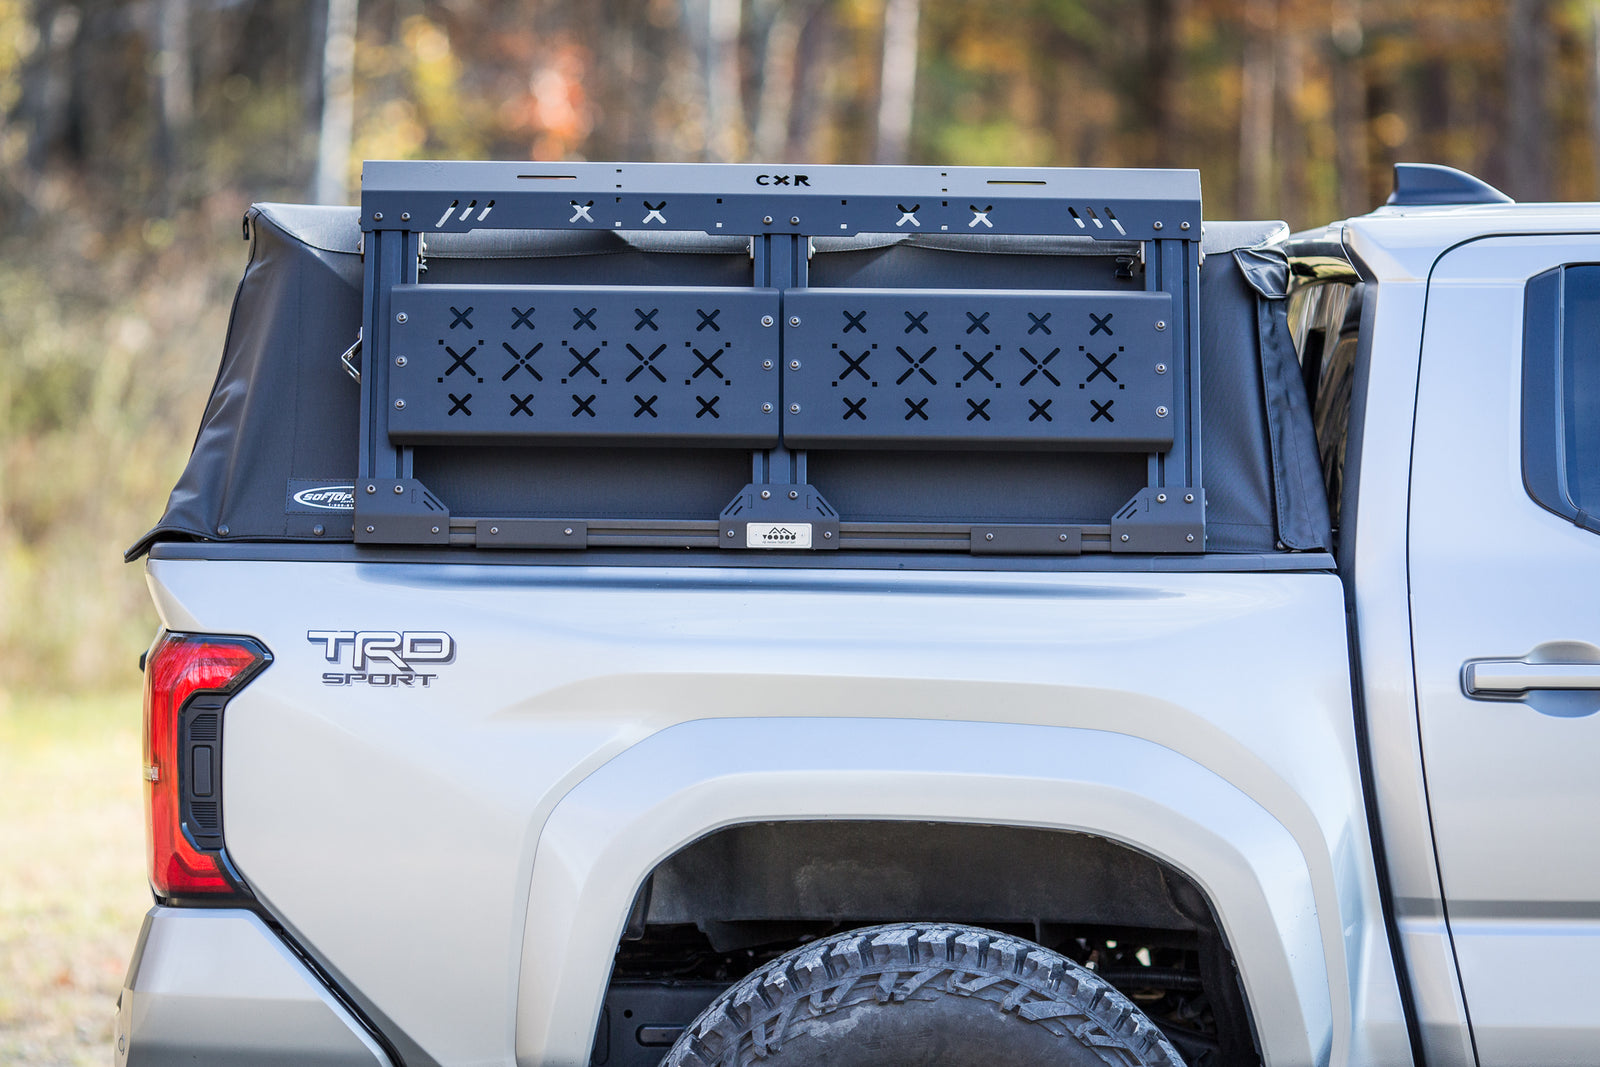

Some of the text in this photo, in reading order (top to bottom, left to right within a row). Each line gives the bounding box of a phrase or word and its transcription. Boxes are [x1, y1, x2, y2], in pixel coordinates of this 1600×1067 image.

[756, 174, 811, 186] CXR
[303, 491, 354, 503] SOFTOP
[307, 630, 456, 672] TRD
[322, 672, 438, 687] SPORT
